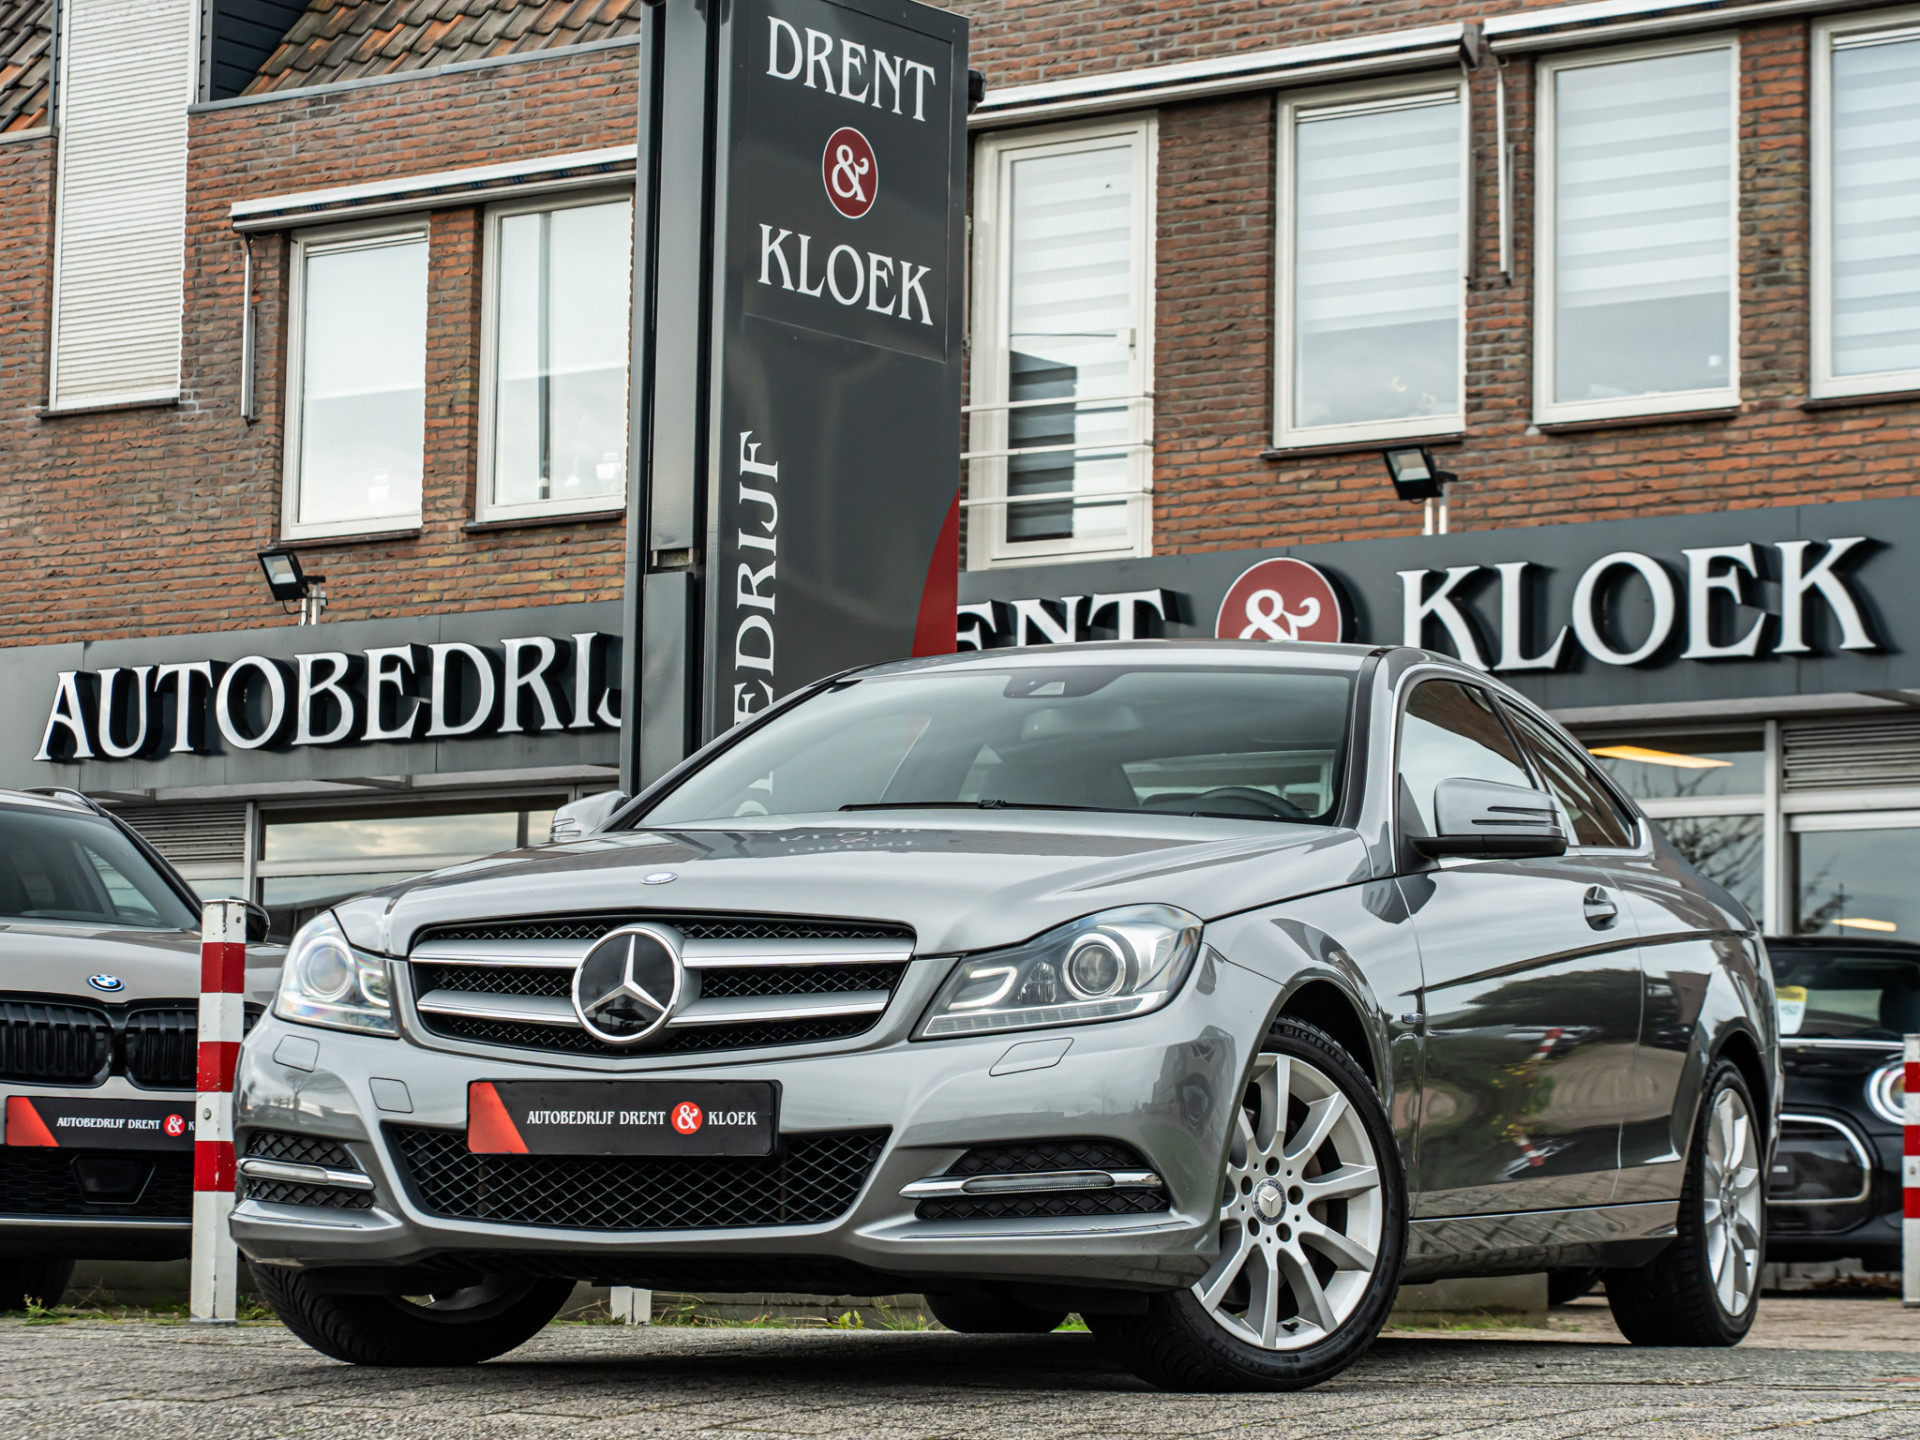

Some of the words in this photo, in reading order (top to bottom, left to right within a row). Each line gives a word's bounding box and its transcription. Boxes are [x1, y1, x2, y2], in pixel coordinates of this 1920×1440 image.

[766, 15, 936, 122] DRENT
[831, 144, 869, 203] &
[757, 223, 934, 326] KLOEK
[1395, 536, 1876, 672] KLOEK
[1282, 1024, 1346, 1066] MICHELIN
[56, 1116, 126, 1129] AUTOBEDRIJF
[127, 1118, 161, 1130] DRENT
[167, 1115, 183, 1134] &
[526, 1110, 616, 1125] AUTOBEDRIJF
[619, 1110, 667, 1125] DRENT
[676, 1104, 699, 1130] &
[708, 1111, 758, 1126] KLOEK
